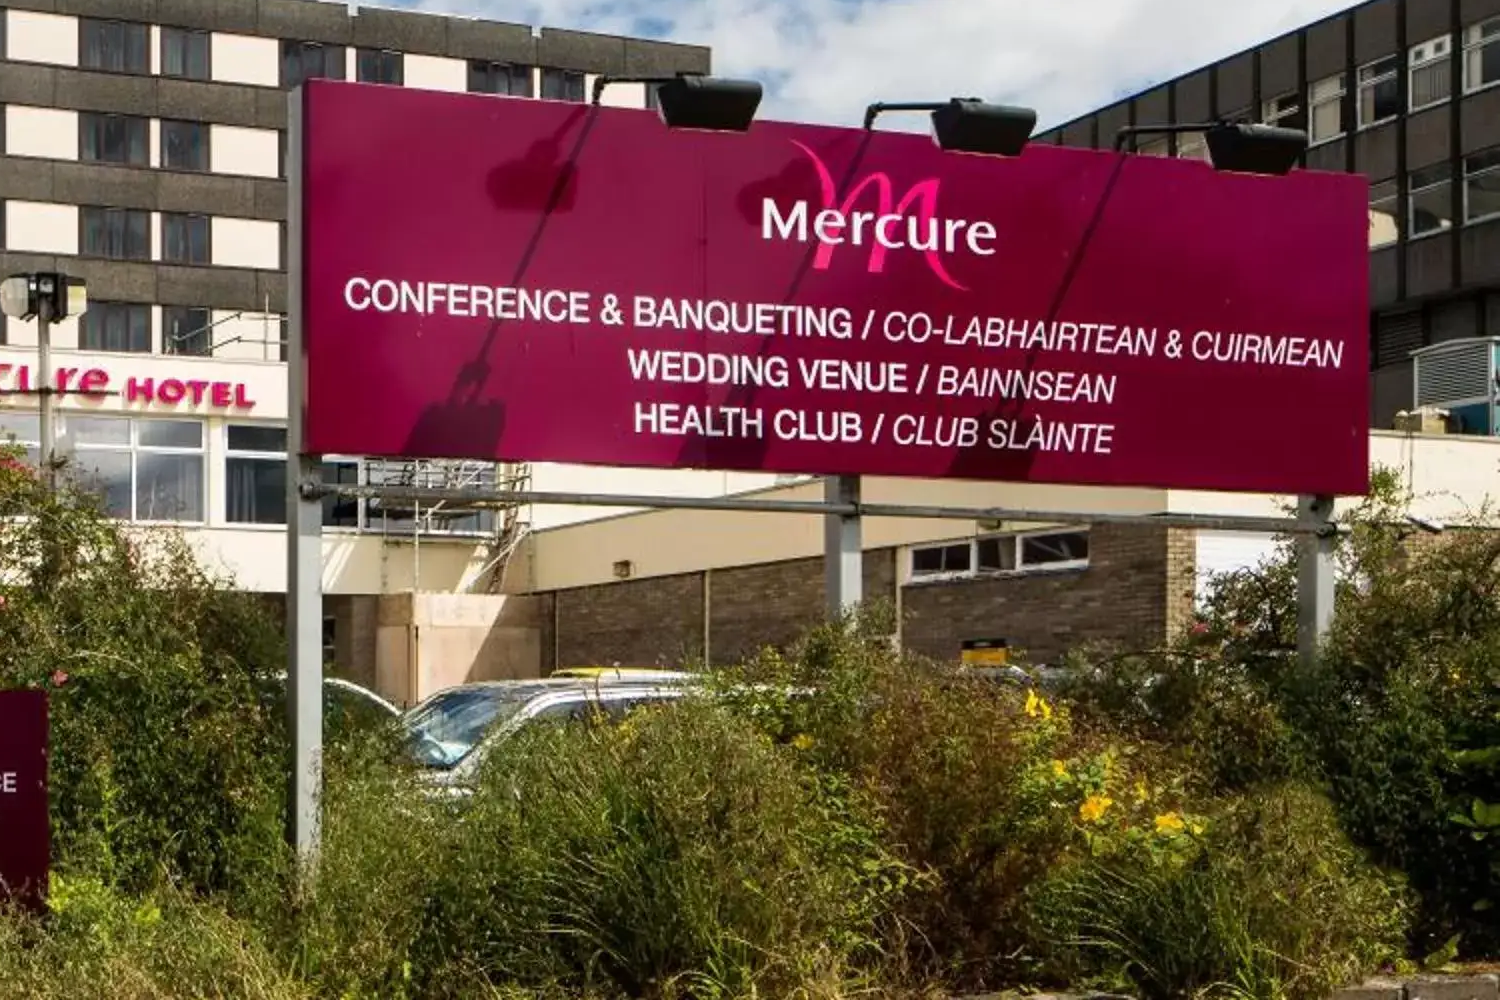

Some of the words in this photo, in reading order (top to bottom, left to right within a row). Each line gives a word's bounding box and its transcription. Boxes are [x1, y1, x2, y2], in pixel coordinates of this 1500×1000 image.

[762, 197, 997, 255] Mercure
[344, 277, 591, 323] CONFERENCE
[600, 293, 624, 325] &
[634, 295, 852, 339] BANQUETING
[861, 309, 876, 340] /
[883, 311, 1157, 357] CO-LABHAIRTEAN
[1163, 329, 1183, 359] &
[1192, 331, 1344, 368] CUIRMEAN
[127, 376, 256, 407] HOTEL
[628, 348, 789, 388] WEDDING
[798, 358, 908, 393] VENUE
[915, 364, 929, 395] /
[937, 365, 1117, 404] BAINNSEAN
[634, 402, 763, 439] HEALTH
[773, 408, 863, 442] CLUB
[871, 413, 884, 445] /
[893, 414, 979, 447] CLUB
[987, 414, 1115, 454] SLÀINTE
